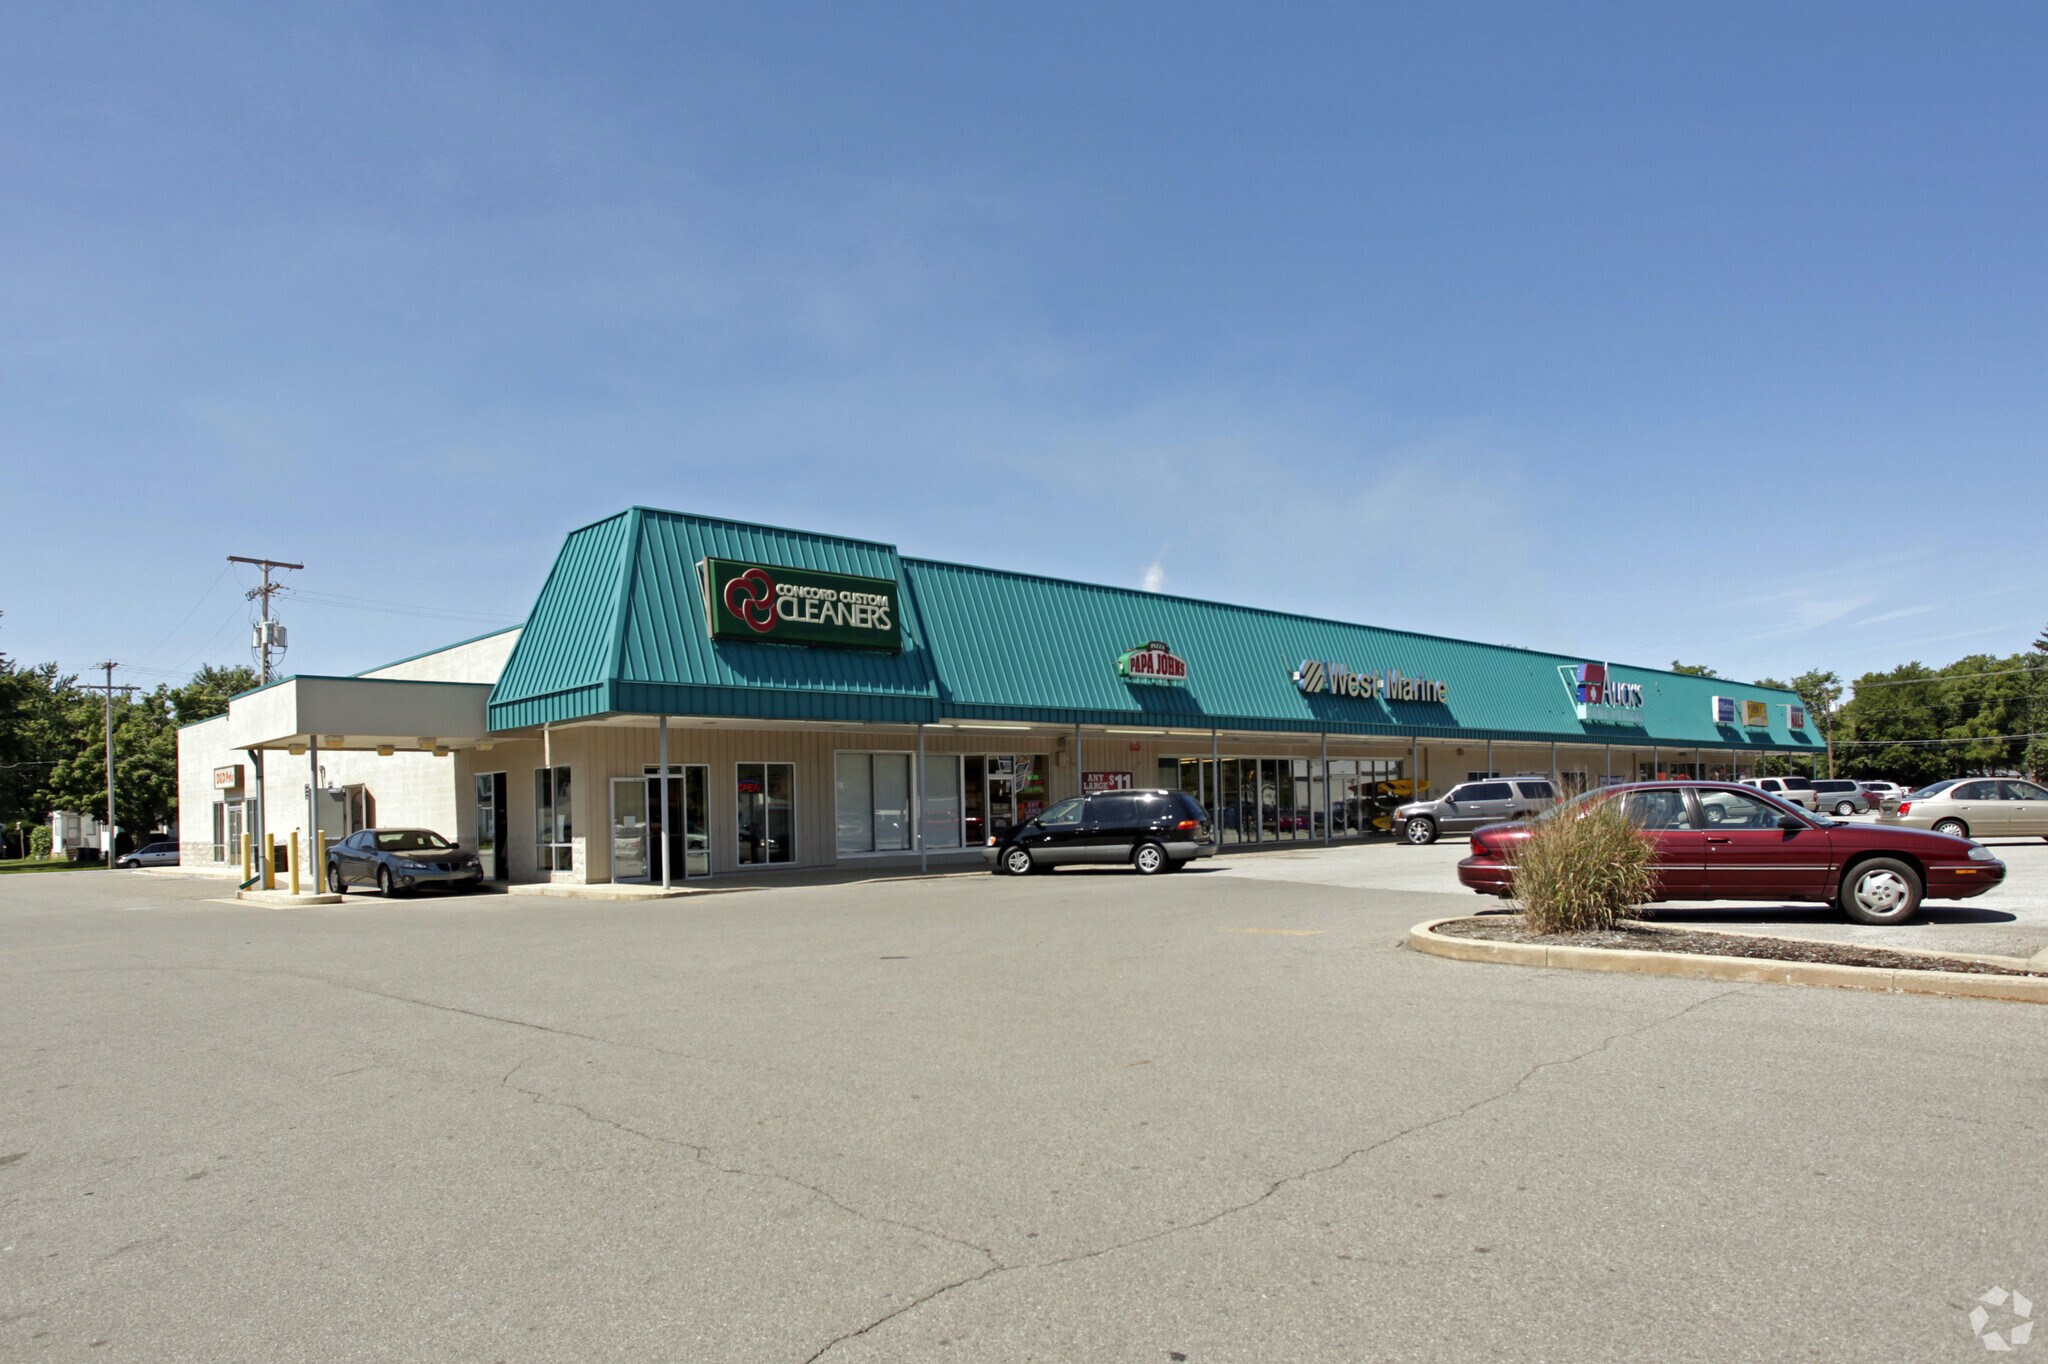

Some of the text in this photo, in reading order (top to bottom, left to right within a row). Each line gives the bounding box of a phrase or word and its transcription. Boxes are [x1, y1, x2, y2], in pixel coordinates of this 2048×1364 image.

[776, 584, 888, 607] CONCORD CUSTOM
[777, 596, 892, 631] CLEANERS
[1130, 653, 1154, 674] PAPA
[1326, 661, 1449, 703] West Marine
[1083, 782, 1108, 790] LARGE
[1088, 773, 1104, 781] ANY
[1109, 774, 1131, 790] $11
